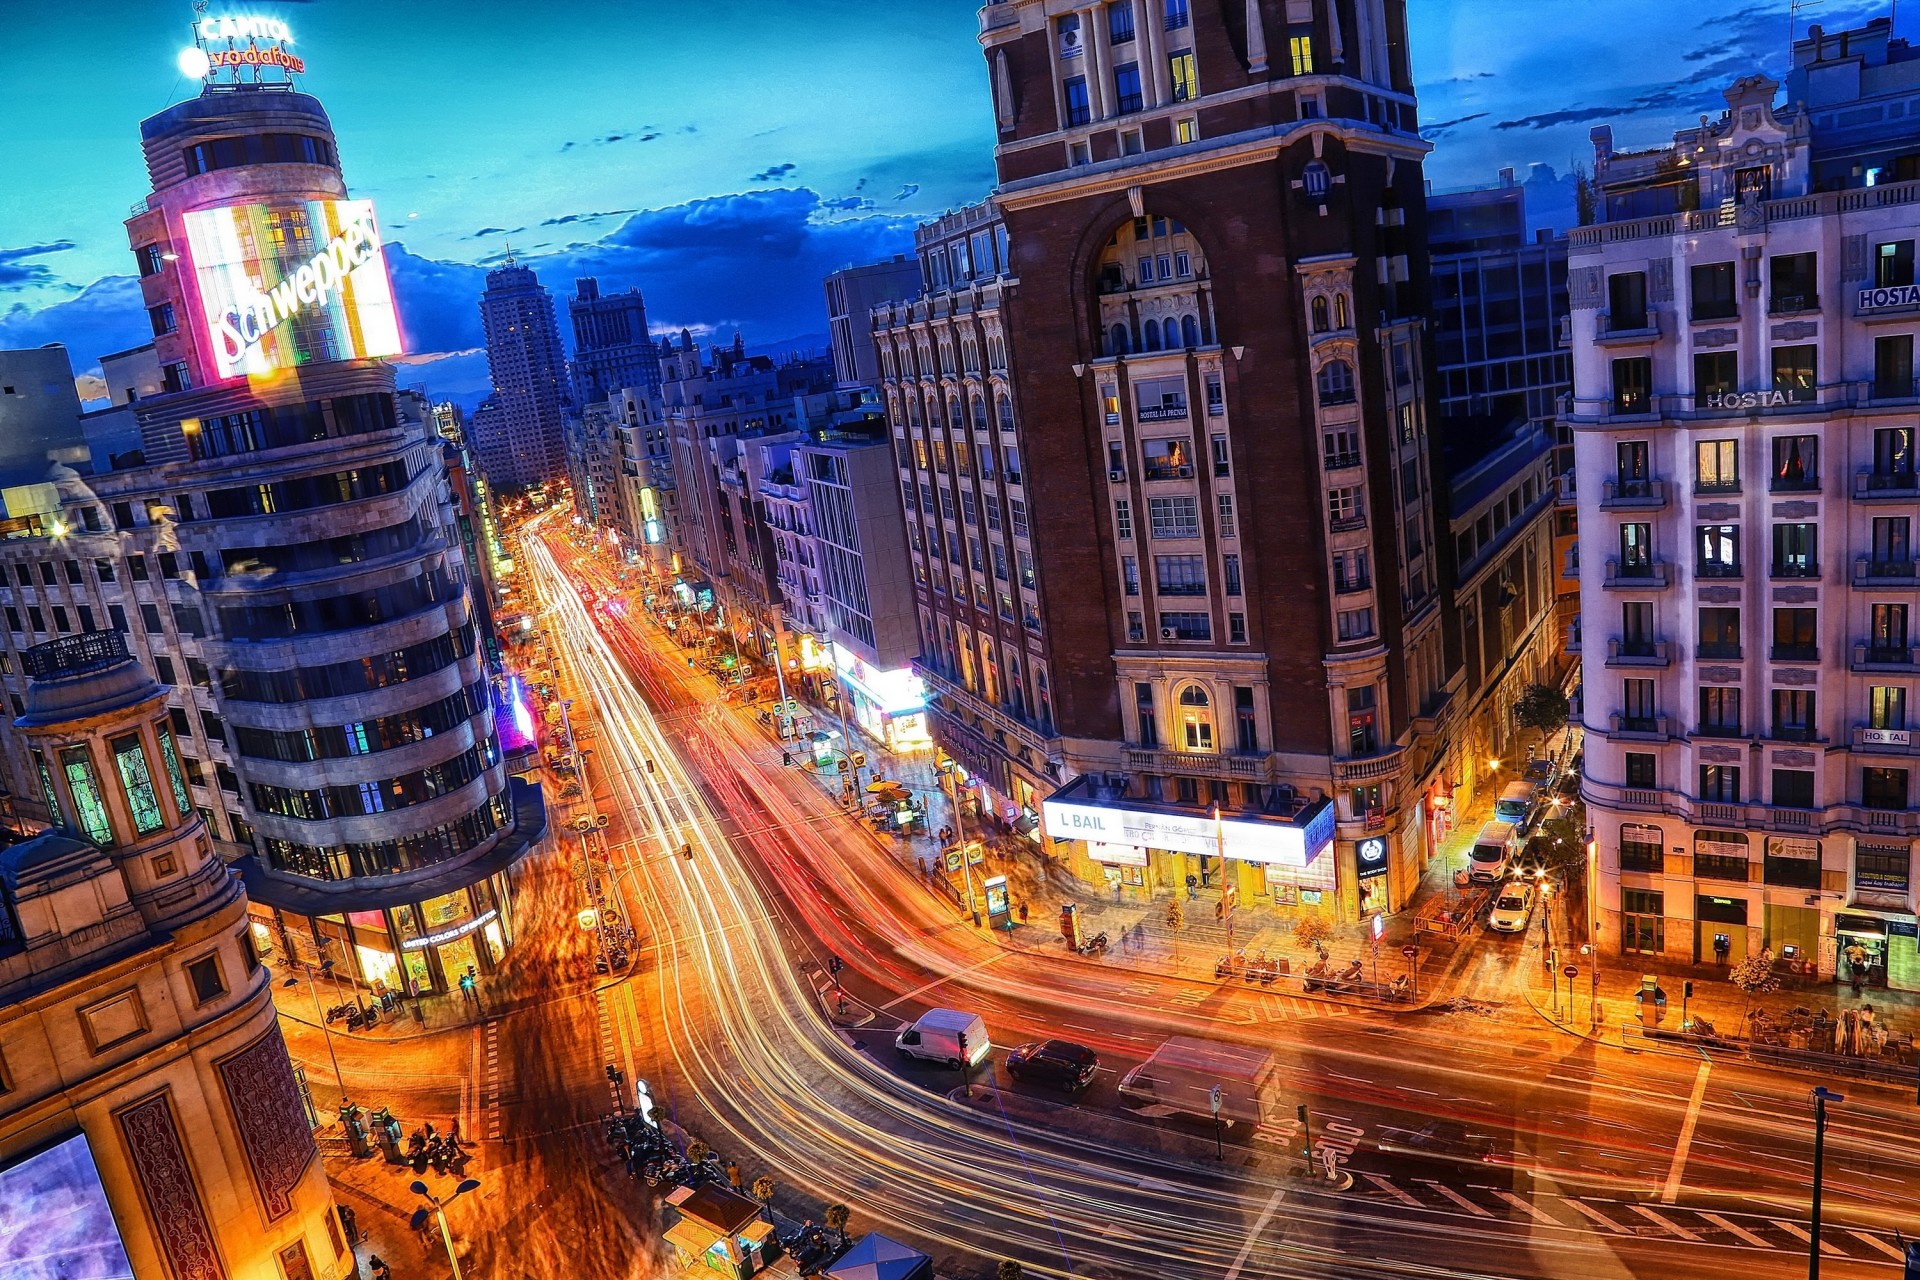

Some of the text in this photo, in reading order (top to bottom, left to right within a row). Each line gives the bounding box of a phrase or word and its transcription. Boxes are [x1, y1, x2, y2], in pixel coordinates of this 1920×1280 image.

[210, 44, 305, 73] vodafone
[219, 211, 380, 365] Schweppes
[1860, 286, 1920, 307] HOSTA
[1707, 389, 1802, 410] HOSTAL
[477, 481, 489, 515] HOTEL
[462, 520, 502, 670] HOTEL REX
[1072, 814, 1106, 831] BAIL
[1169, 987, 1212, 1008] BUS
[1251, 1114, 1302, 1147] BUS
